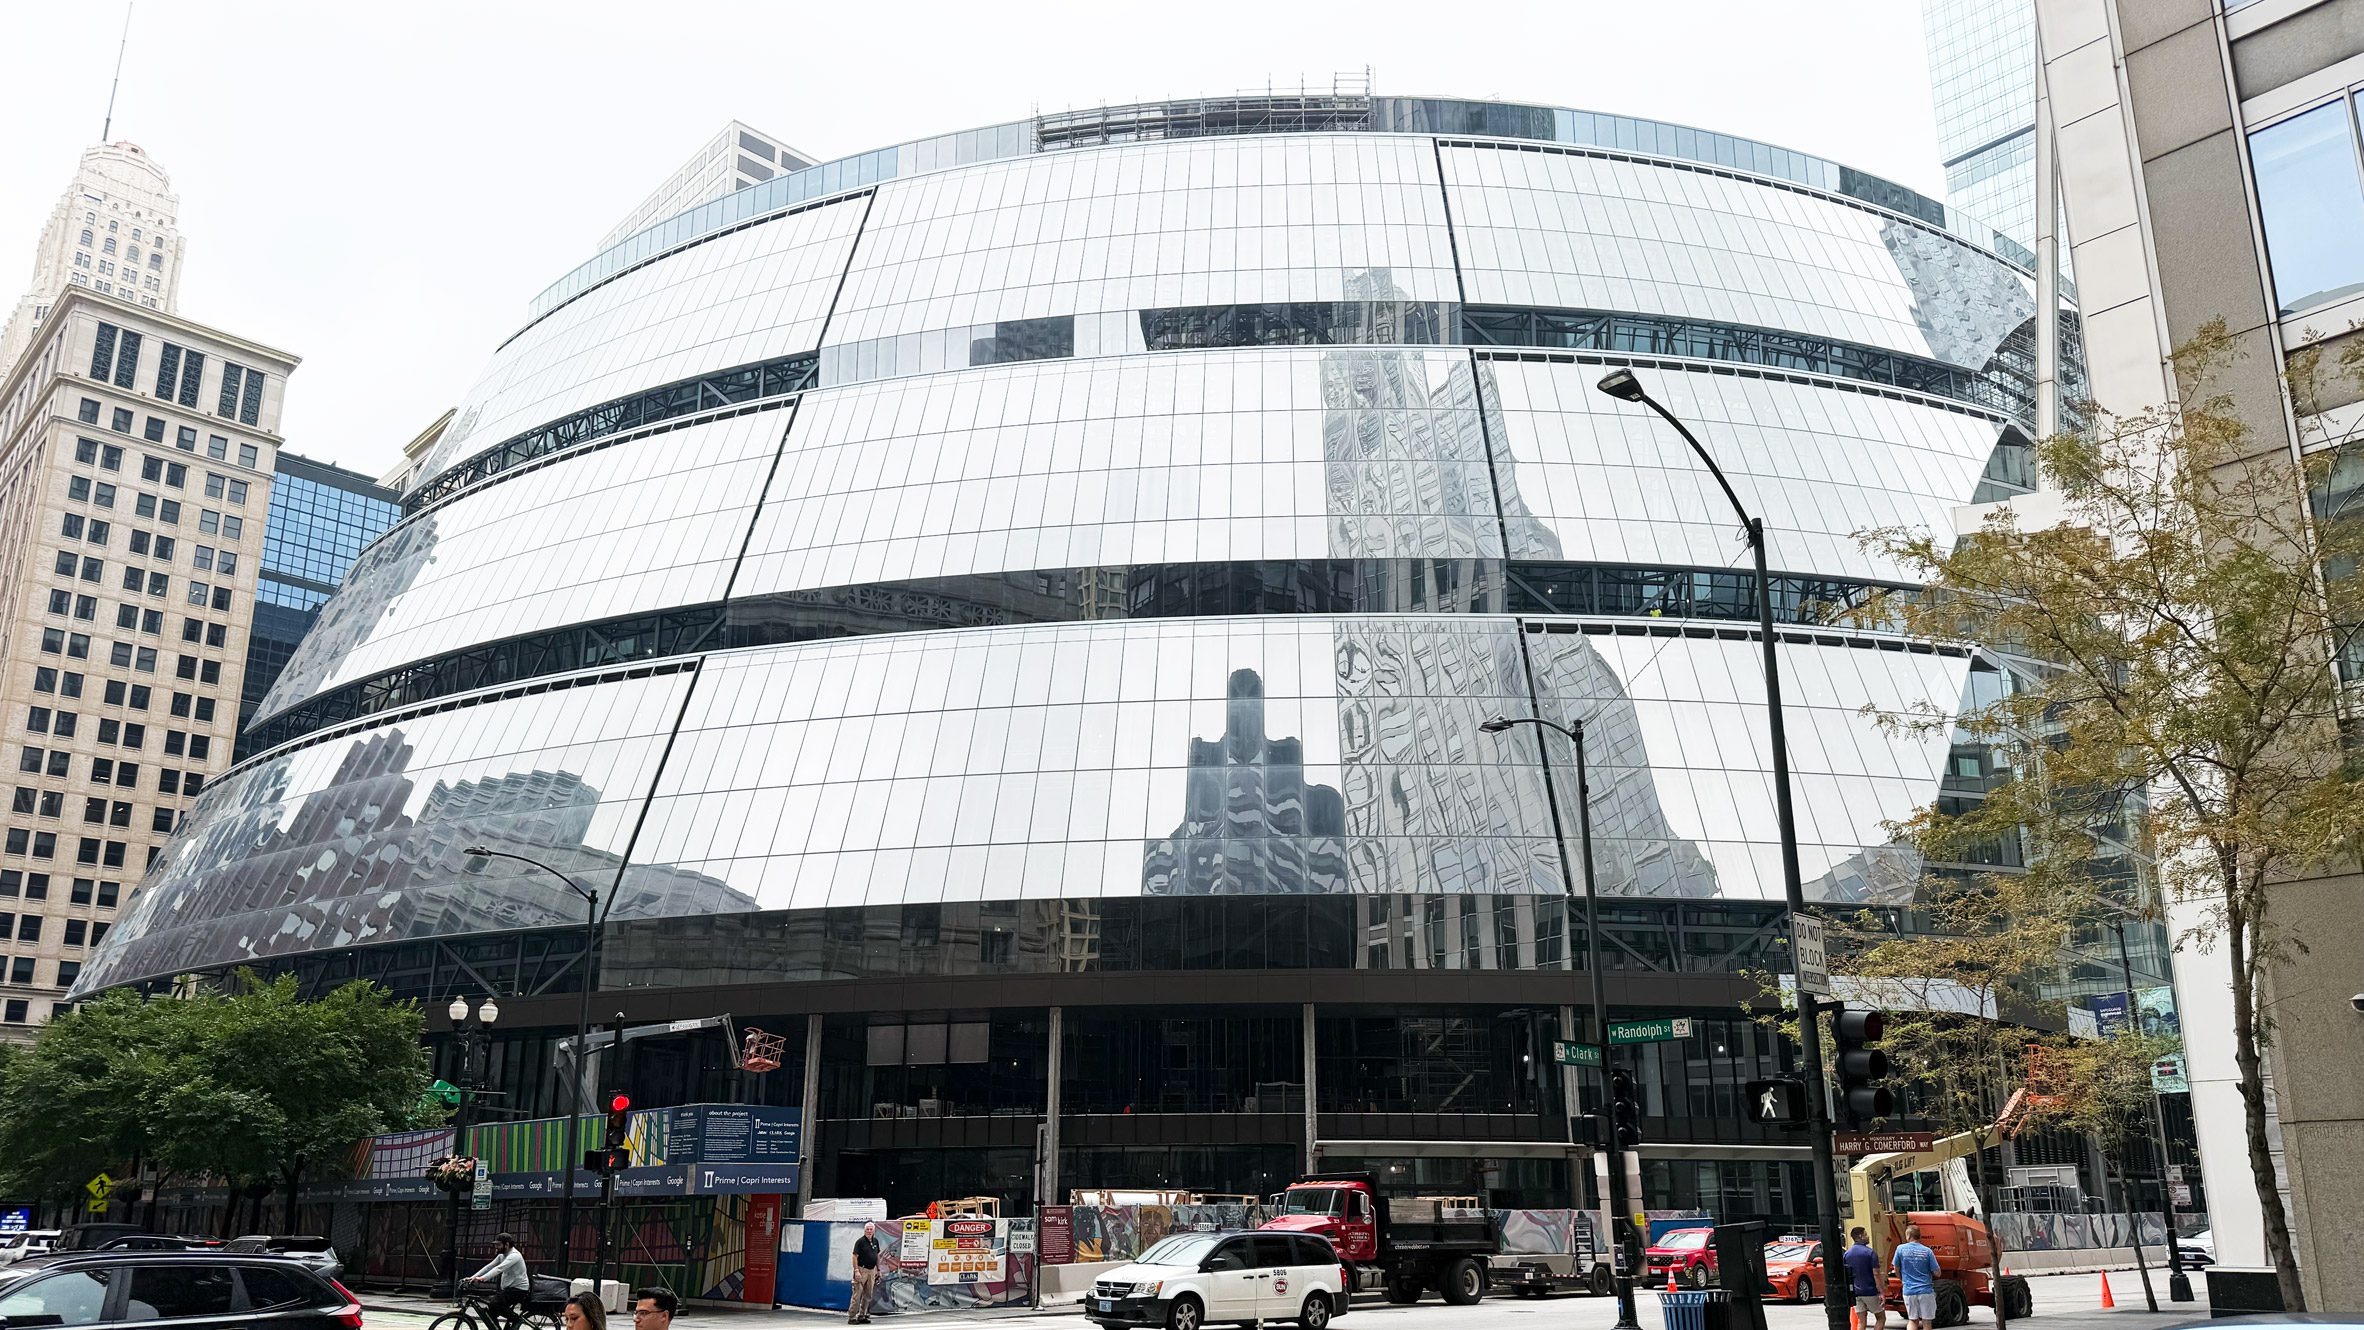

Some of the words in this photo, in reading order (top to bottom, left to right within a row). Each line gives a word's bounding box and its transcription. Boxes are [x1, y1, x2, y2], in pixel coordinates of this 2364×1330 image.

[1797, 923, 1806, 939] DO
[1808, 925, 1821, 942] NOT
[1800, 947, 1824, 968] BLOCK
[1802, 970, 1827, 986] INTERSECTION
[1618, 1024, 1662, 1039] Randolph
[1571, 1046, 1593, 1060] Clark
[1840, 1141, 1861, 1151] HARRY
[1865, 1141, 1872, 1150] G.
[1874, 1140, 1916, 1151] COMERFORD
[1904, 1155, 1916, 1169] LIFT
[529, 1181, 543, 1191] Google
[643, 1178, 661, 1186] Interests
[667, 1175, 684, 1187] Google
[715, 1176, 736, 1184] Prime
[740, 1176, 760, 1186] Capri
[761, 1176, 791, 1184] Interests
[1057, 1216, 1069, 1225] kirk
[954, 1224, 986, 1232] DANGER
